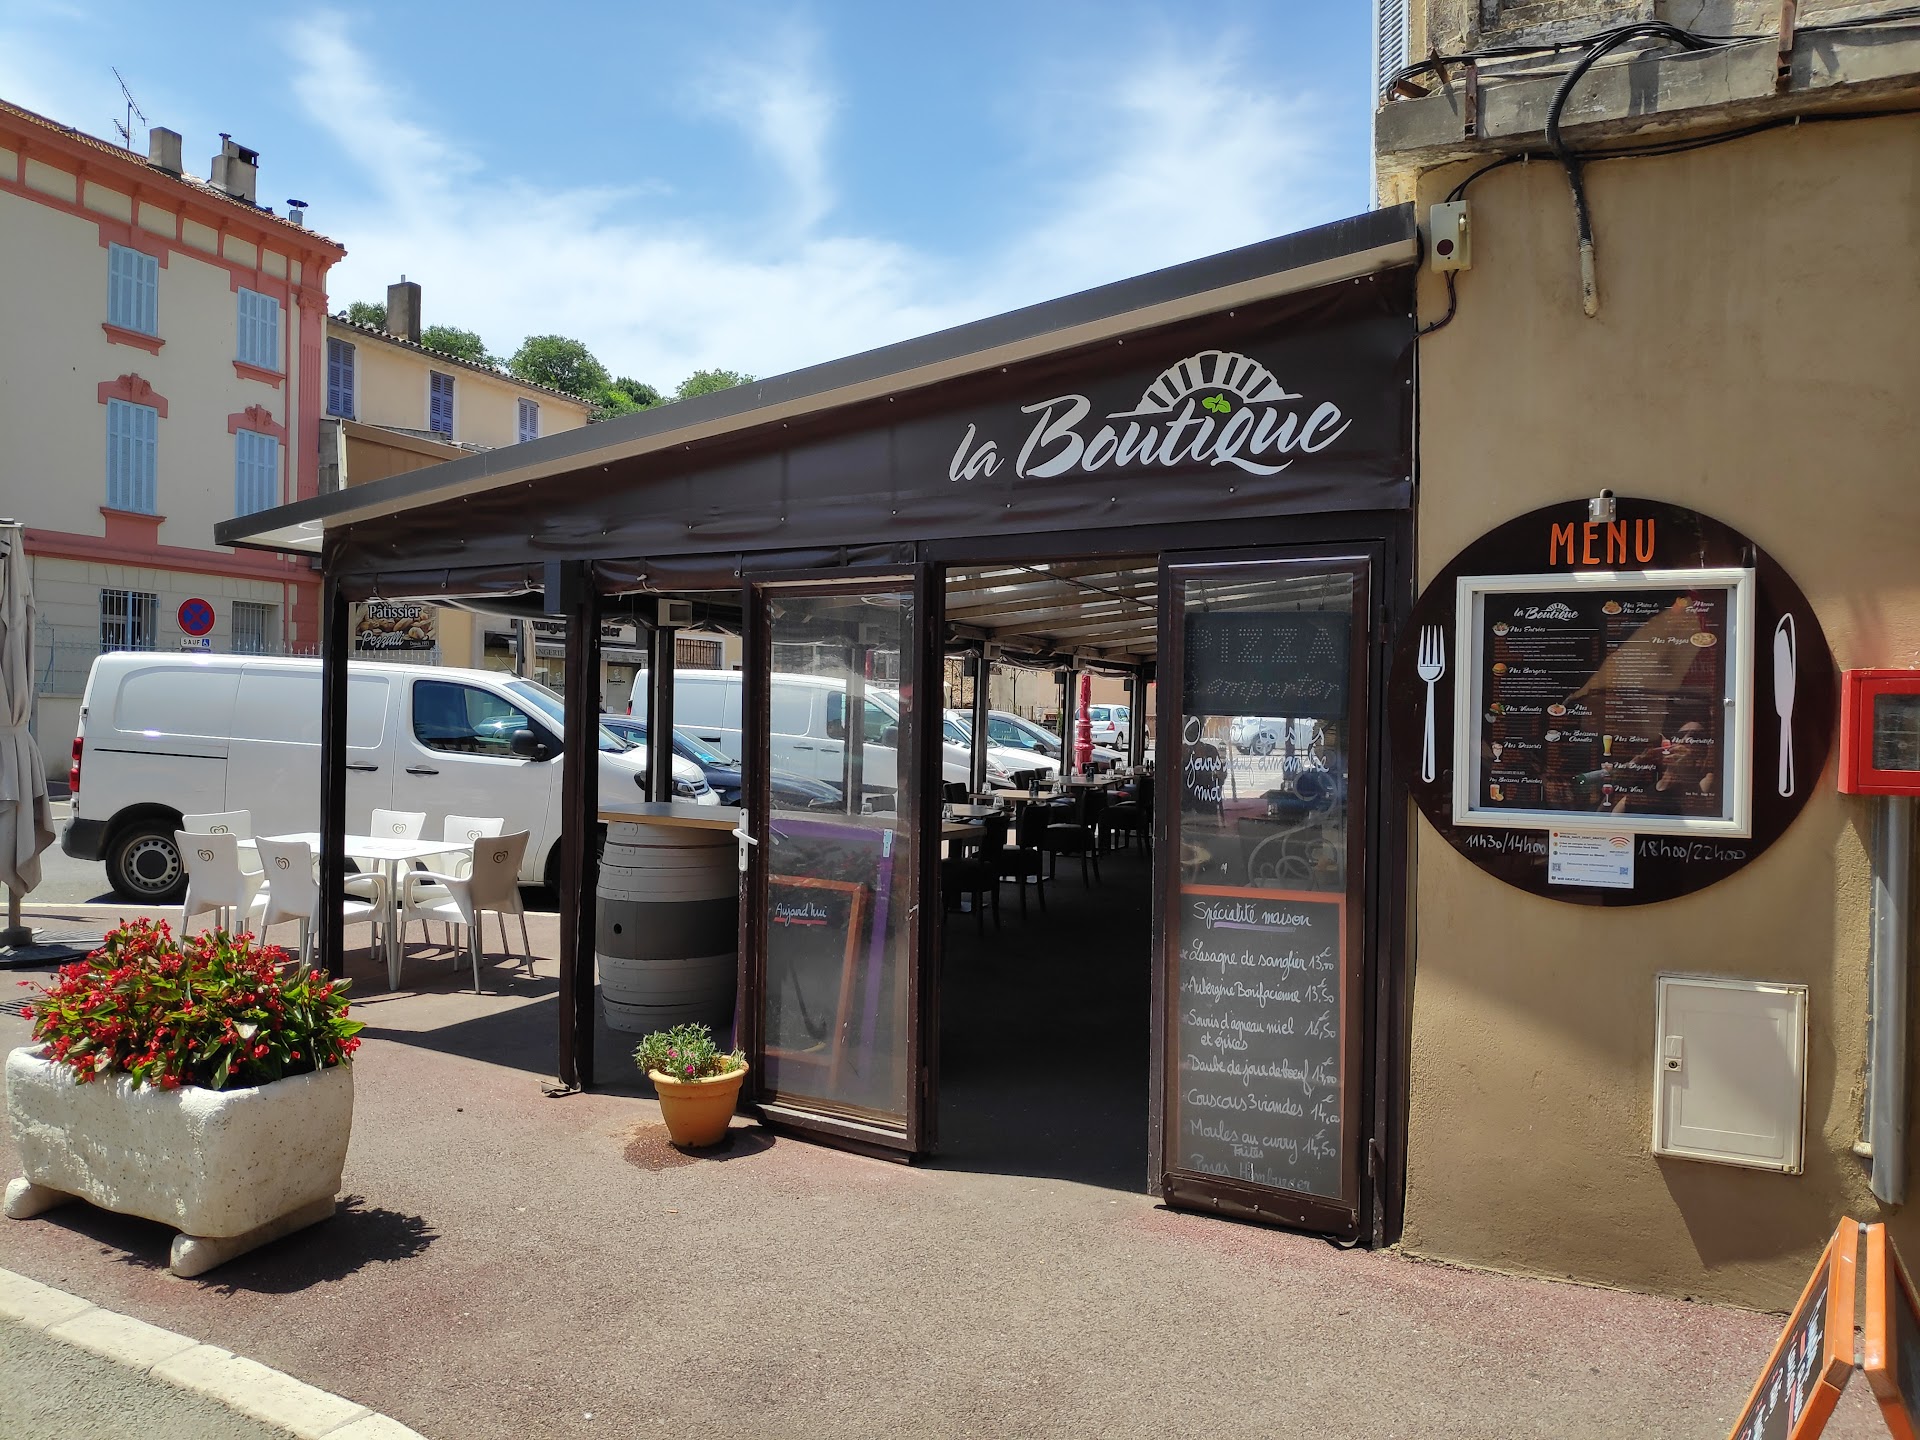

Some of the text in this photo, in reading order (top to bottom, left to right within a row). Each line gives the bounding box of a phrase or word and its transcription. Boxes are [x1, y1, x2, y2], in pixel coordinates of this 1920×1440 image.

[948, 422, 1005, 482] la
[1550, 518, 1656, 566] MENU
[368, 603, 421, 619] Pâtissier
[1187, 628, 1338, 663] PIZZA
[1667, 637, 1689, 646] Pizzas
[1207, 672, 1340, 704] emporter
[1192, 901, 1312, 929] Spécialité maison
[1189, 938, 1237, 974] Lasagne
[1240, 950, 1256, 967] de
[1257, 950, 1307, 981] sanglier
[1187, 976, 1235, 1003] Aubergine
[1187, 1008, 1220, 1027] Souris
[1266, 1016, 1295, 1035] miel
[1200, 1031, 1249, 1055] et épices
[1187, 1054, 1226, 1072] Daube
[1226, 1059, 1242, 1076] de
[1241, 1059, 1268, 1087] joue
[1187, 1088, 1248, 1112] Couscous
[1190, 1118, 1239, 1142] Moules
[1241, 1133, 1259, 1145] au
[1262, 1136, 1298, 1165] curry
